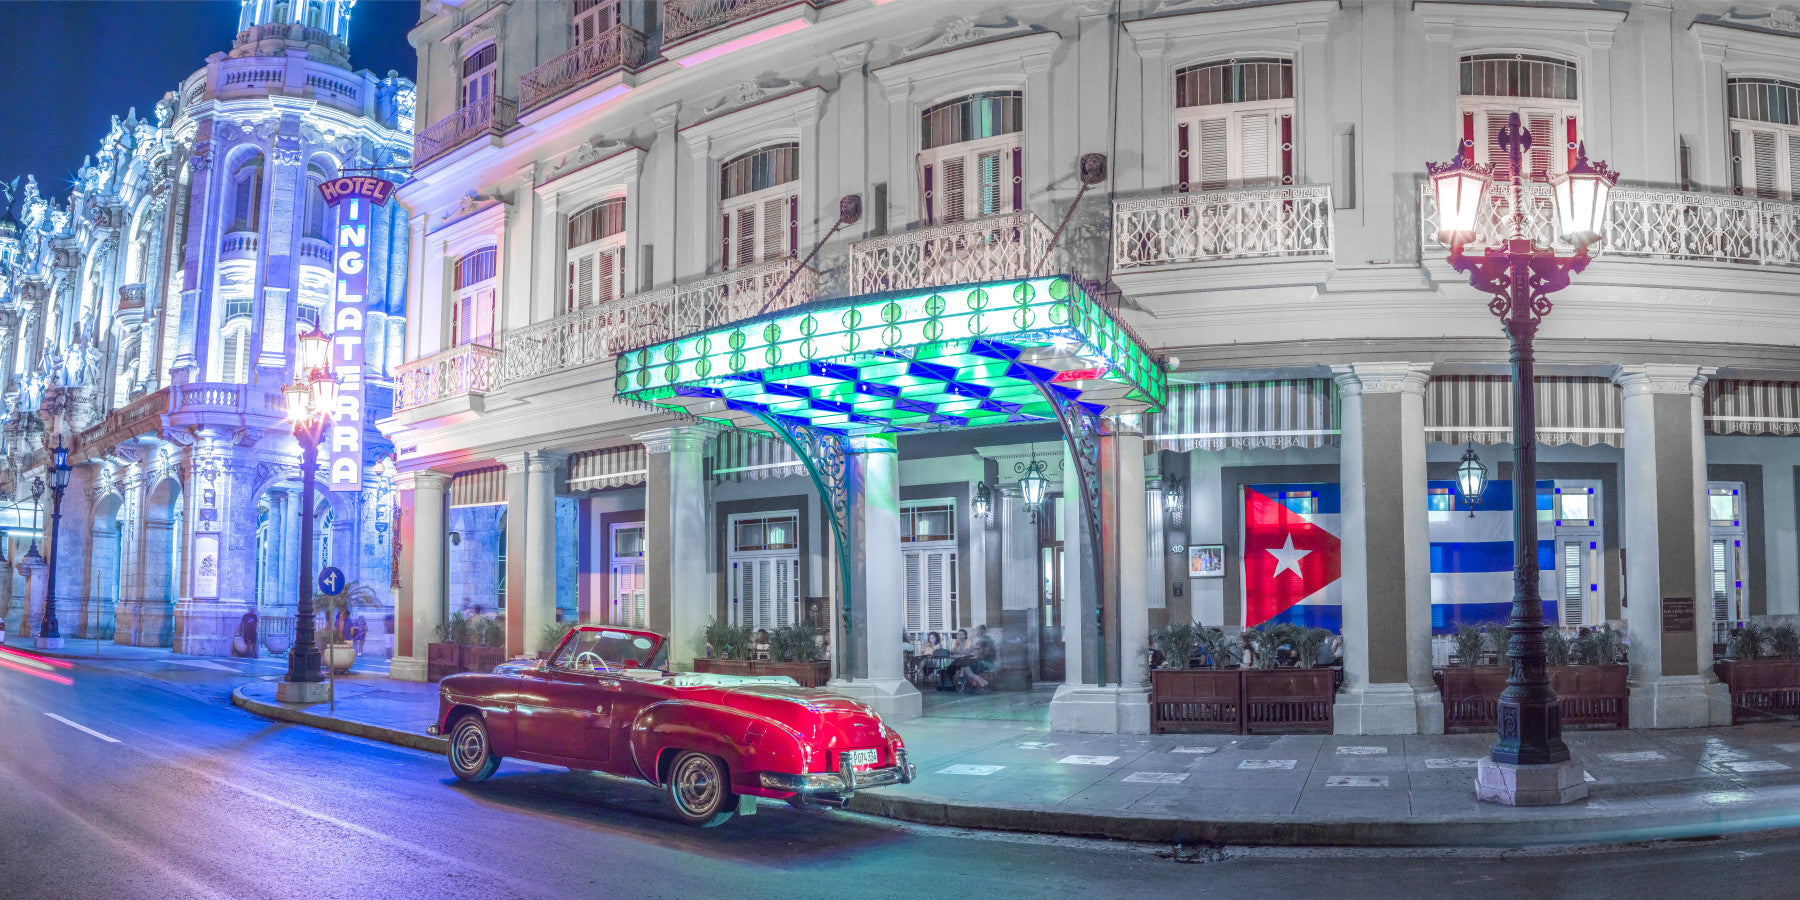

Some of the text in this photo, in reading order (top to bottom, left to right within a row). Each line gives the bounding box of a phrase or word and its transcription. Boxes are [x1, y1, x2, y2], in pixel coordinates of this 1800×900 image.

[321, 177, 384, 200] HOTEL
[331, 198, 366, 484] INGLATERRA
[1732, 421, 1800, 432] HOTEL INGLA
[1192, 436, 1300, 448] HOTEL INGLATERRA
[1465, 432, 1500, 441] HOTEL
